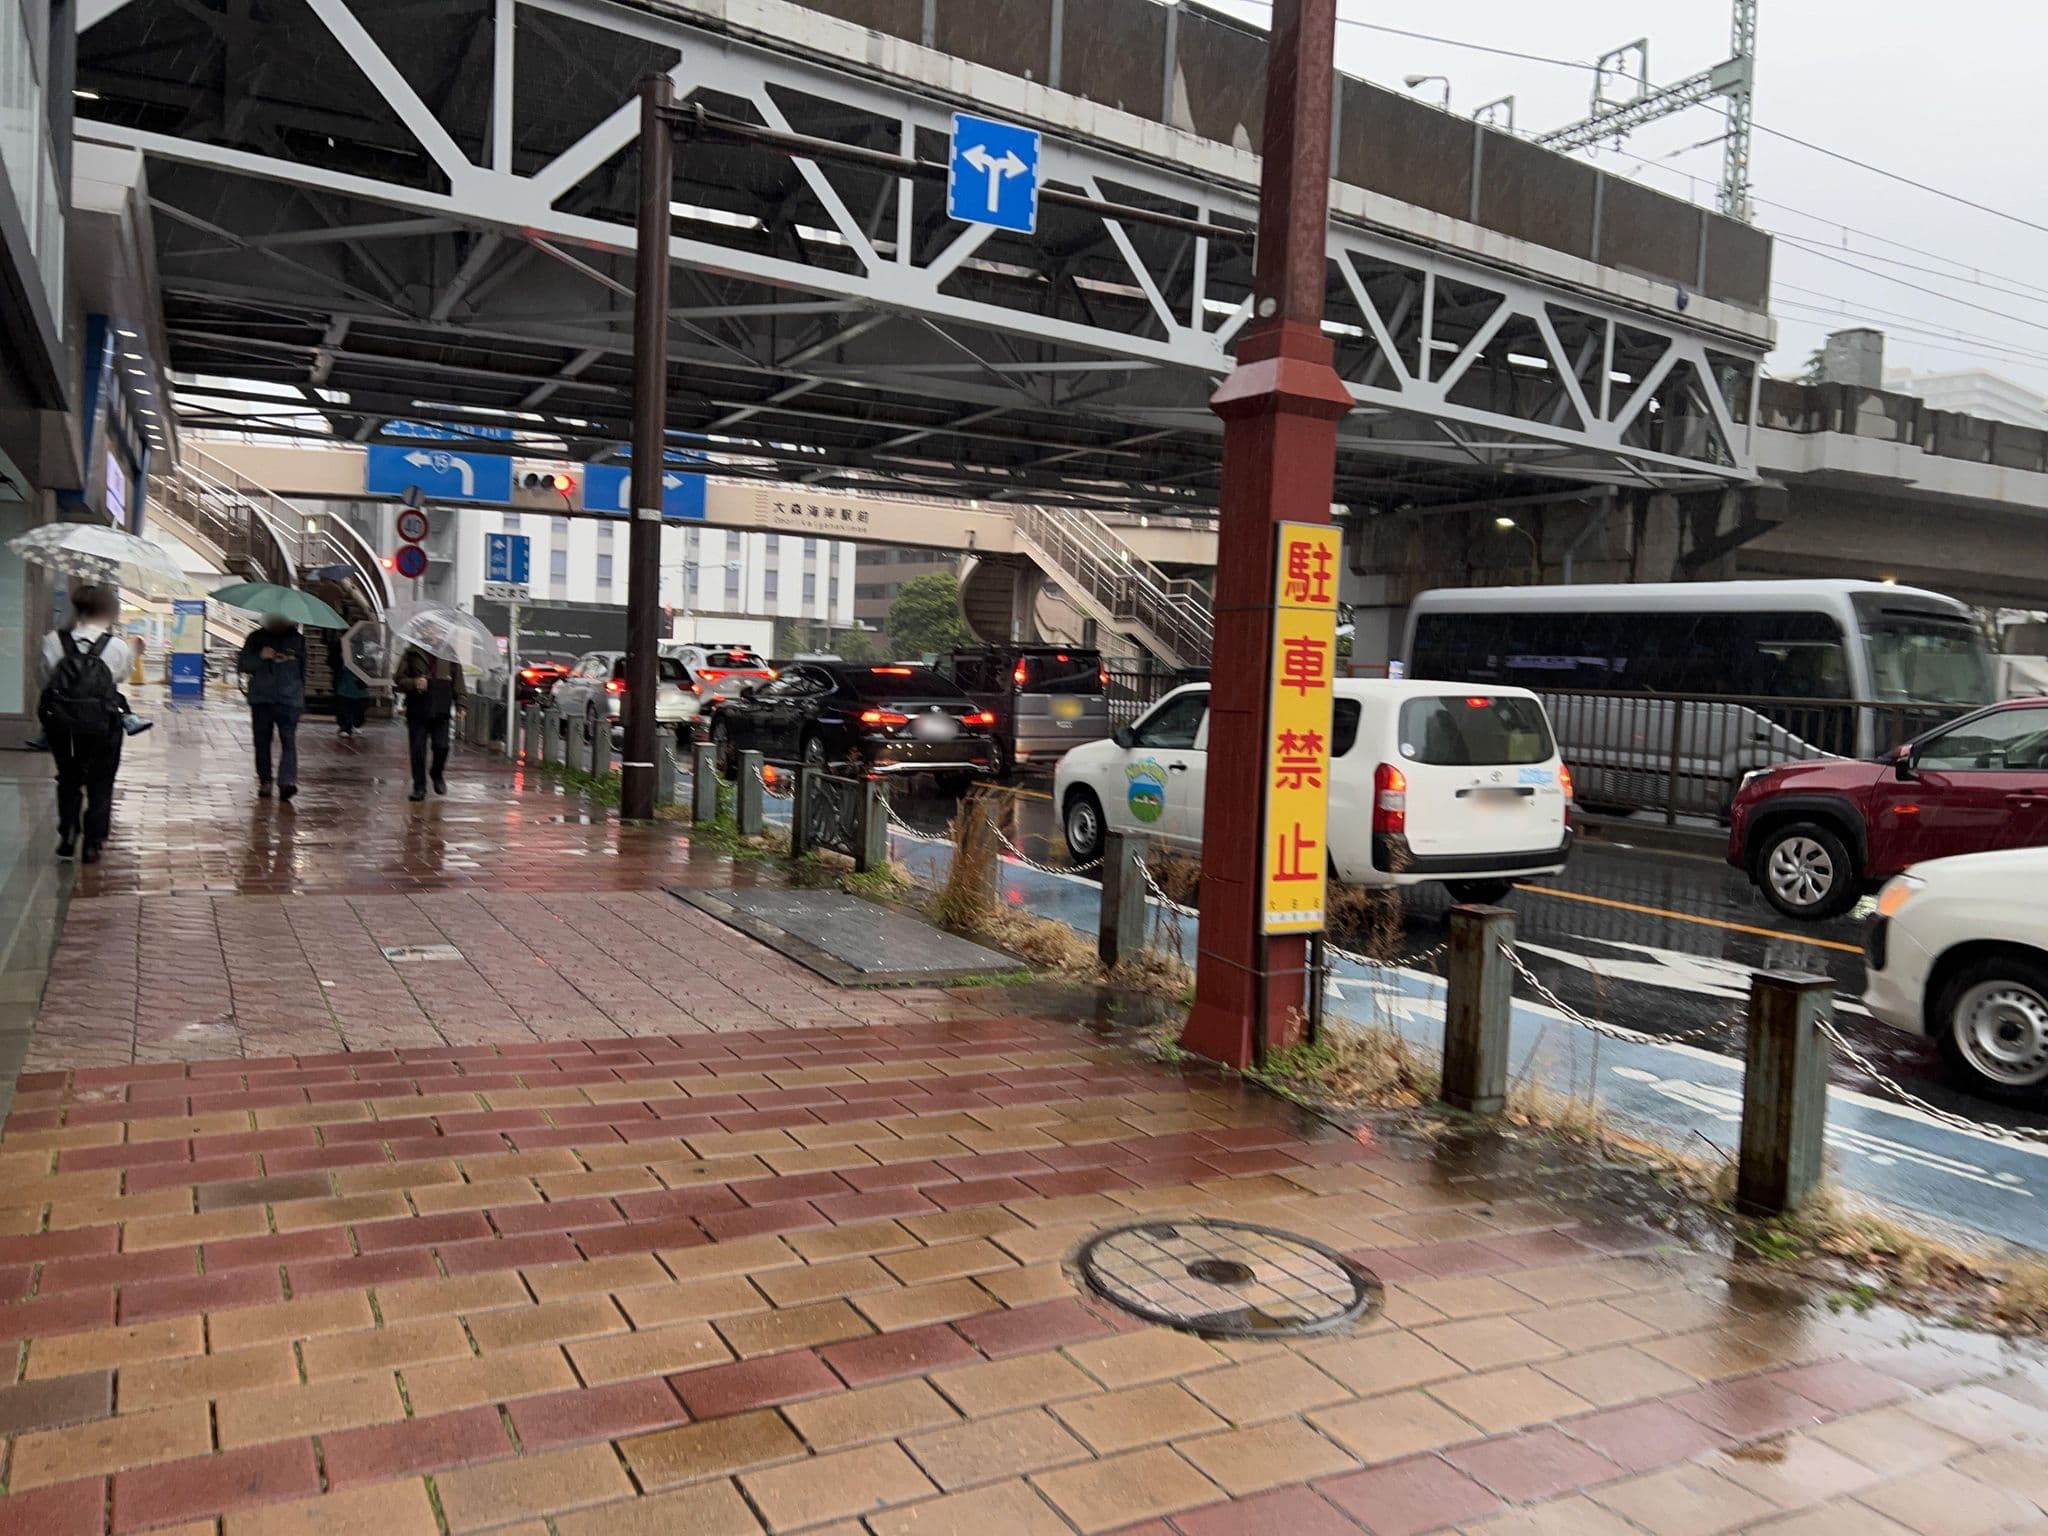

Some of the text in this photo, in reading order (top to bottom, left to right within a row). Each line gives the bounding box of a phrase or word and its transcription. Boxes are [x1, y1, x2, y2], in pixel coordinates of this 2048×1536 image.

[773, 502, 869, 523] 大森海岸駅前
[1272, 541, 1334, 882] 駐車禁止
